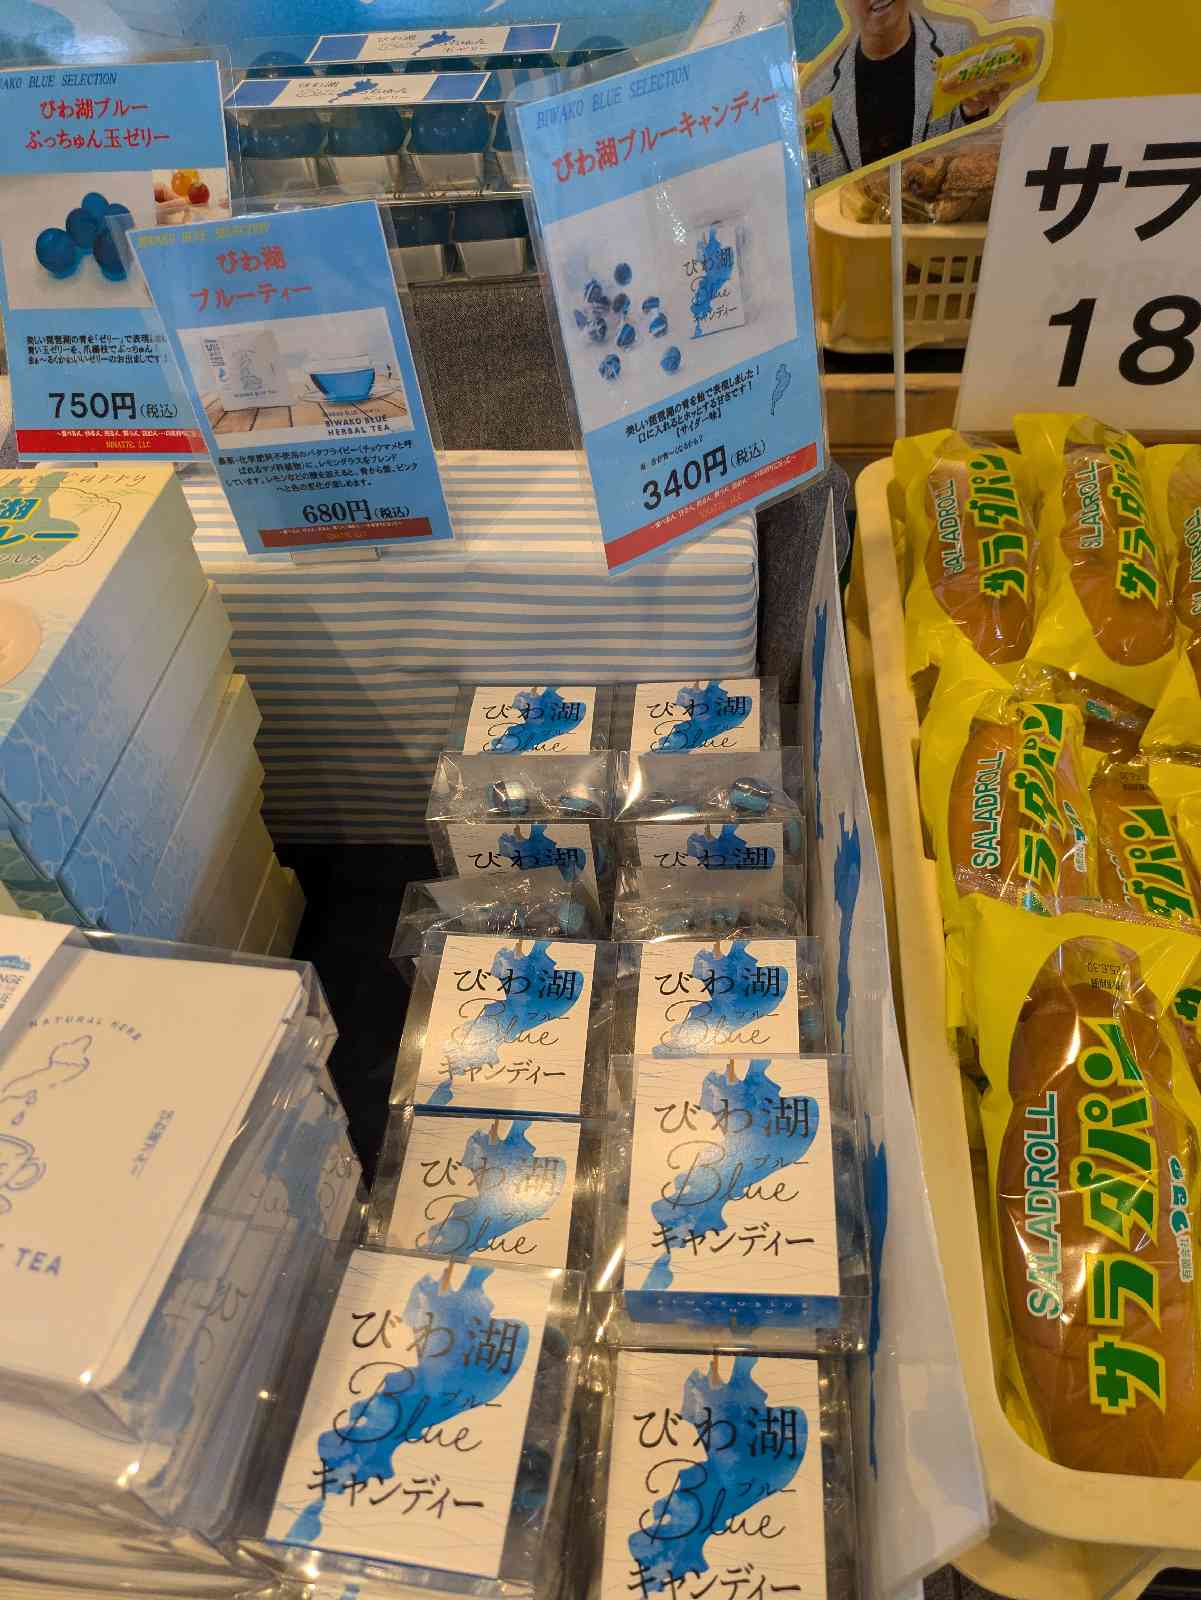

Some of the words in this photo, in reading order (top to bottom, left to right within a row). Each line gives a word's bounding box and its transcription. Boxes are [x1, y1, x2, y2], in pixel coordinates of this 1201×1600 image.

[28, 75, 55, 88] BLUE
[61, 72, 117, 87] SELECTION
[536, 98, 585, 129] BIWAKO
[592, 86, 622, 112] BLUE
[629, 64, 690, 98] SELECTION
[40, 98, 149, 119] びわ湖ブルー
[552, 89, 779, 182] びわ湖ブルーキャンディー
[216, 245, 288, 274] びわ湖
[1048, 294, 1201, 387] 18
[370, 424, 391, 434] TEA
[968, 453, 1027, 600] サラダパン
[1106, 441, 1159, 609] サラダパン
[482, 700, 582, 722] びわ湖
[647, 696, 746, 720] びわ湖
[650, 720, 738, 750] Blue
[970, 751, 1006, 869] SALADROLL
[469, 848, 579, 870] びわ湖
[654, 848, 769, 870] びわ湖
[453, 967, 576, 1000] びわ湖
[654, 966, 782, 998] びわ湖
[450, 998, 560, 1048] Blue
[660, 999, 771, 1049] Blue
[438, 1056, 566, 1085] キャンディー
[654, 1096, 811, 1138] びわ湖
[420, 1156, 559, 1197] びわ湖
[660, 1140, 799, 1211] Blue
[754, 1156, 809, 1170] ブルー
[415, 1194, 538, 1255] Blue
[1024, 1090, 1063, 1322] SALADROLL
[1071, 1018, 1167, 1416] サラダパン
[650, 1222, 816, 1257] キャンディー
[16, 1247, 62, 1277] TEA
[351, 1310, 521, 1375] びわ湖
[332, 1361, 483, 1453] Blue
[441, 1391, 502, 1408] ブルー
[633, 1406, 798, 1460] びわ湖
[307, 1457, 485, 1519] キャンディー
[638, 1458, 787, 1544] Blue
[736, 1480, 797, 1495] ブルー
[627, 1557, 802, 1600] キャンディー
